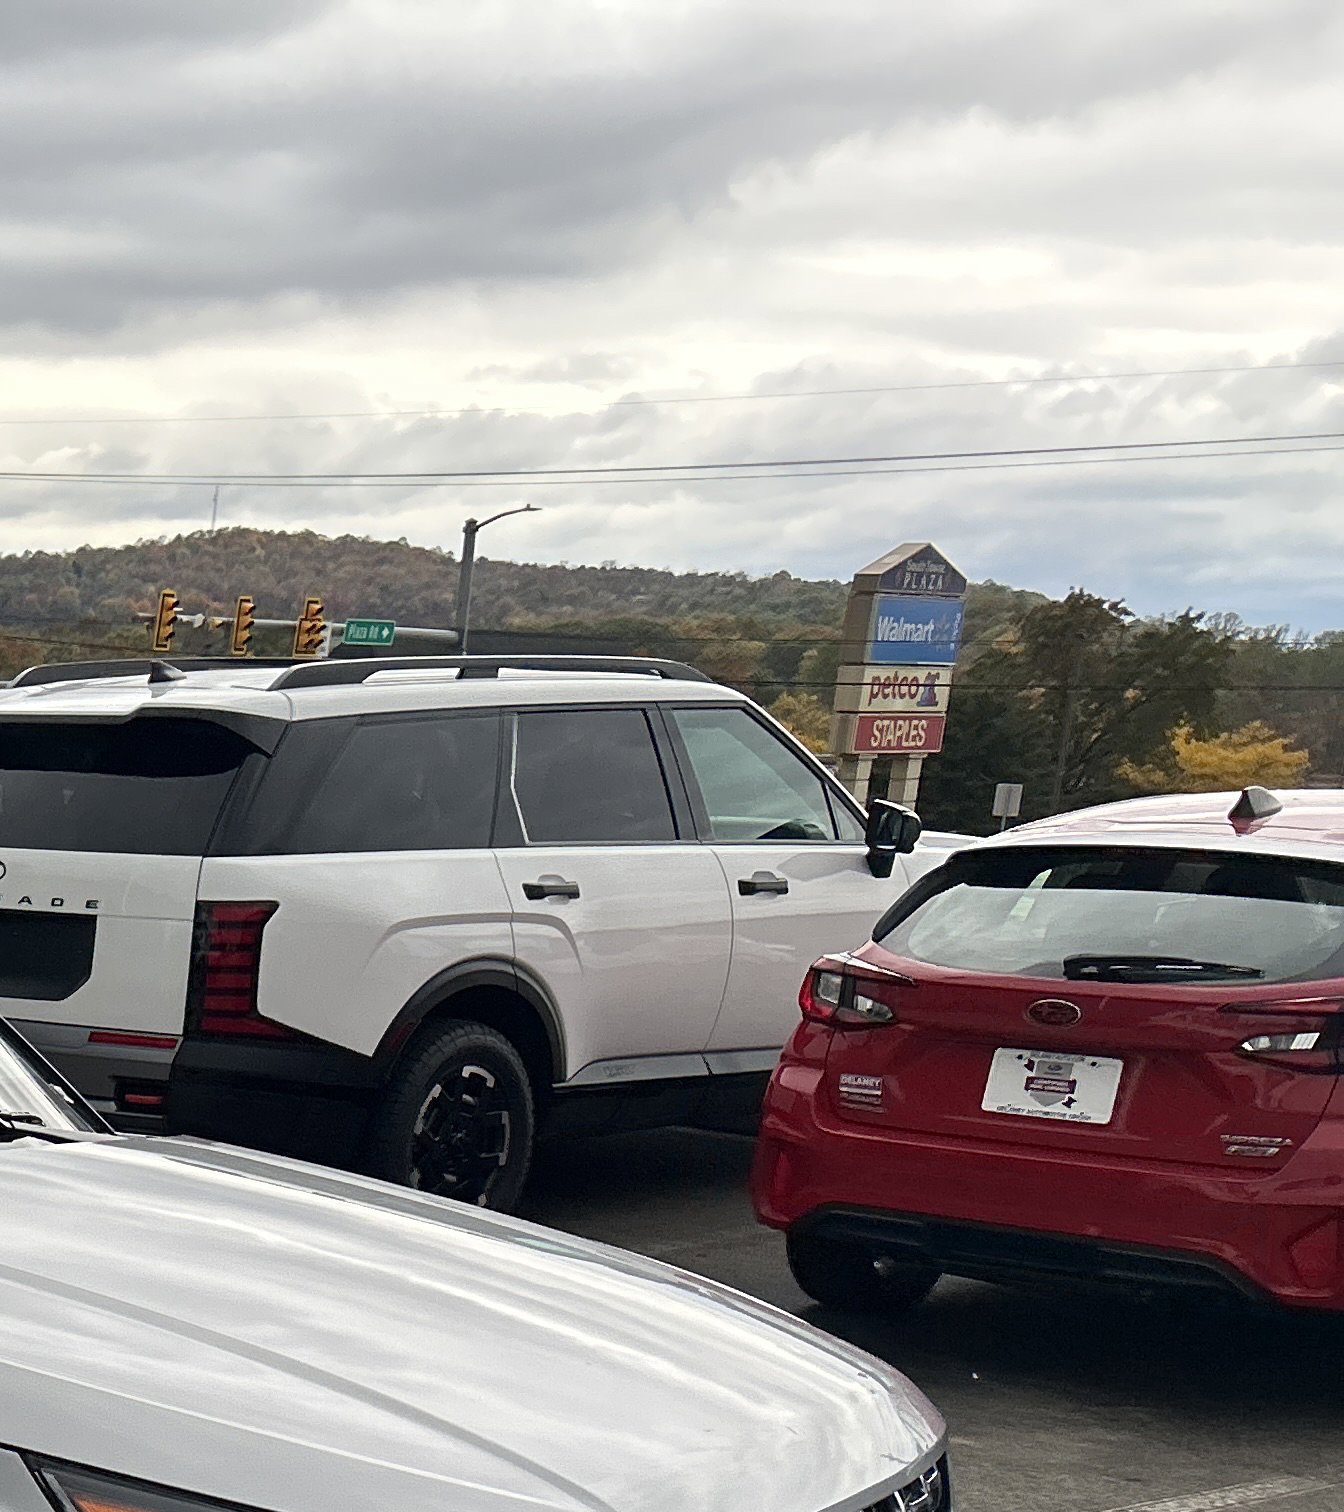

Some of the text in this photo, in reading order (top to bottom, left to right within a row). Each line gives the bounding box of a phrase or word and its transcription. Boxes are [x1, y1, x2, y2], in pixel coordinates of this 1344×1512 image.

[903, 571, 943, 590] PLAZA
[877, 615, 934, 642] Walmart
[868, 670, 919, 707] petco
[870, 719, 928, 747] STAPLES
